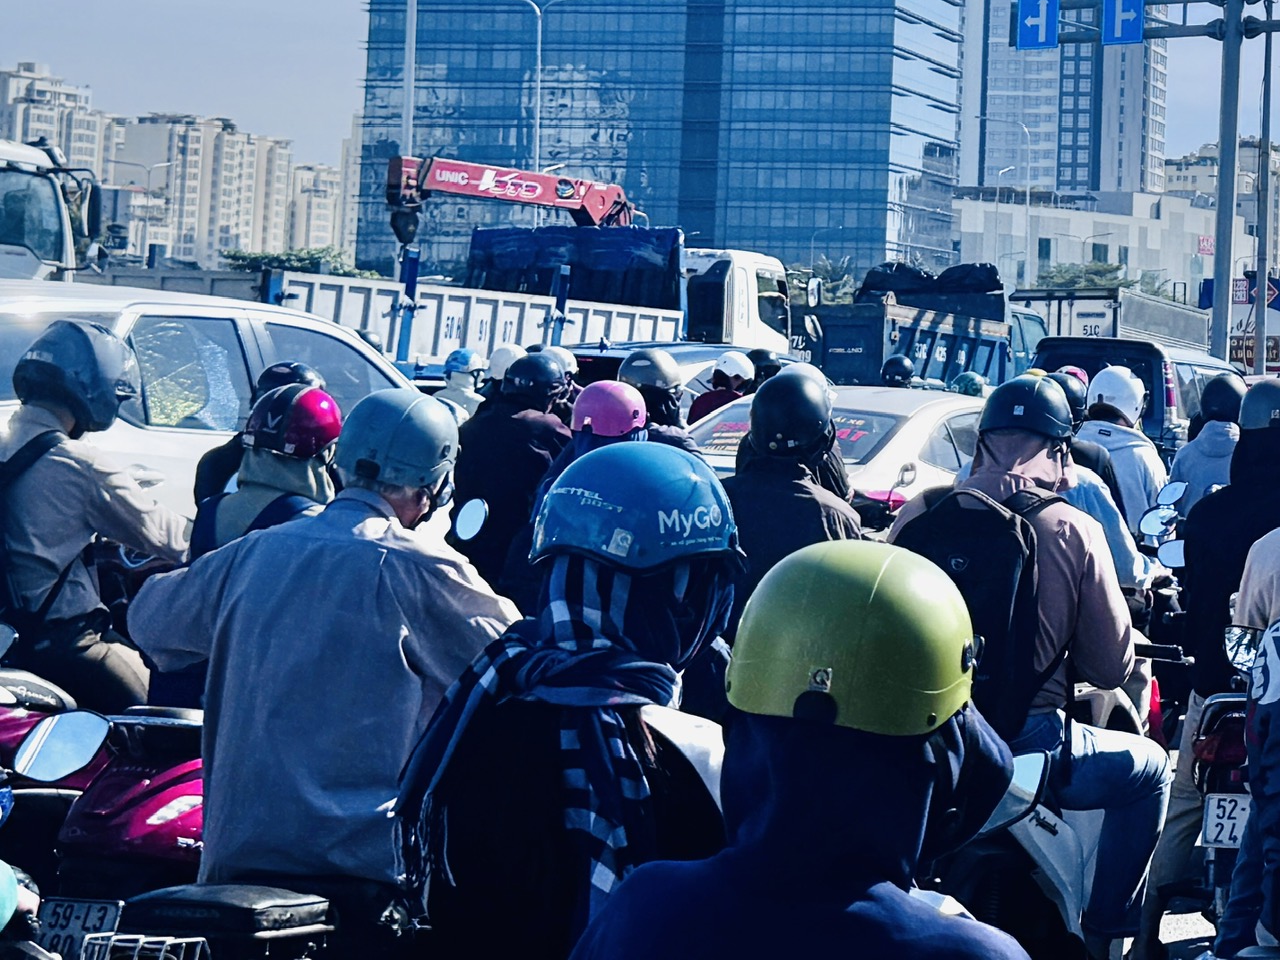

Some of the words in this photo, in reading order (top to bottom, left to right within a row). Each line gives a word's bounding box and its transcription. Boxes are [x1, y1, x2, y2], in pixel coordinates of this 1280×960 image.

[435, 169, 469, 186] UNIC
[1083, 324, 1100, 338] 51C
[48, 902, 109, 933] 59-L3
